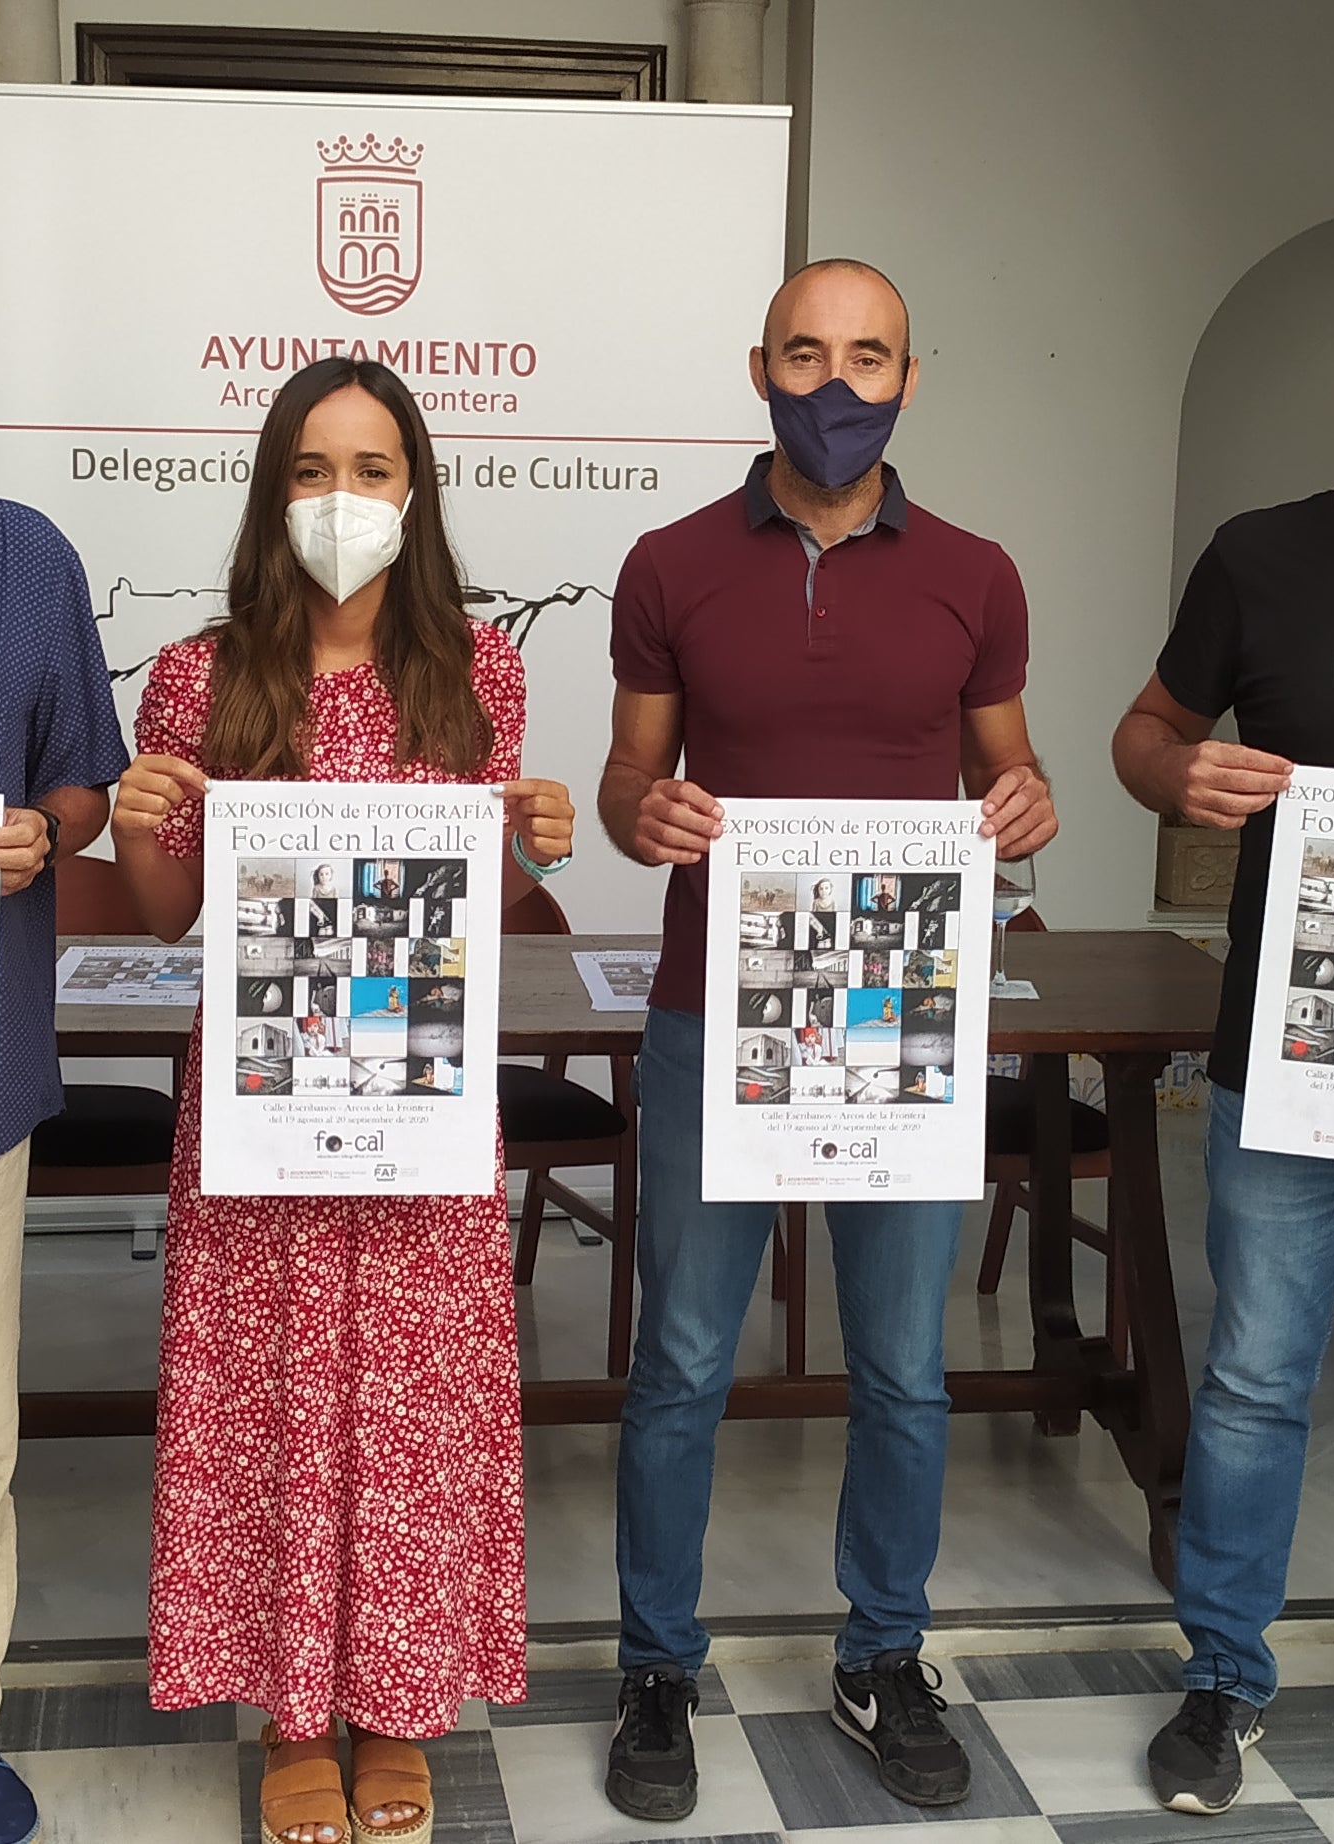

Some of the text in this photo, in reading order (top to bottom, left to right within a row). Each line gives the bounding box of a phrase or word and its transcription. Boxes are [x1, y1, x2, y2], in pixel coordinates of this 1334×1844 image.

[200, 336, 537, 377] AYUNTAMIENTO
[220, 381, 518, 413] Arco rontera
[71, 447, 250, 491] Delegació
[474, 462, 517, 488] de
[529, 457, 660, 491] Cultura
[212, 799, 495, 820] EXPOSICIÓN de FOTOGRAFÍA
[231, 825, 477, 852] Fo-cal en la Calle
[841, 818, 859, 834] de
[735, 841, 971, 866] Fo-cal en la Calle
[374, 1168, 397, 1177] FAF
[868, 1174, 890, 1183] FAF
